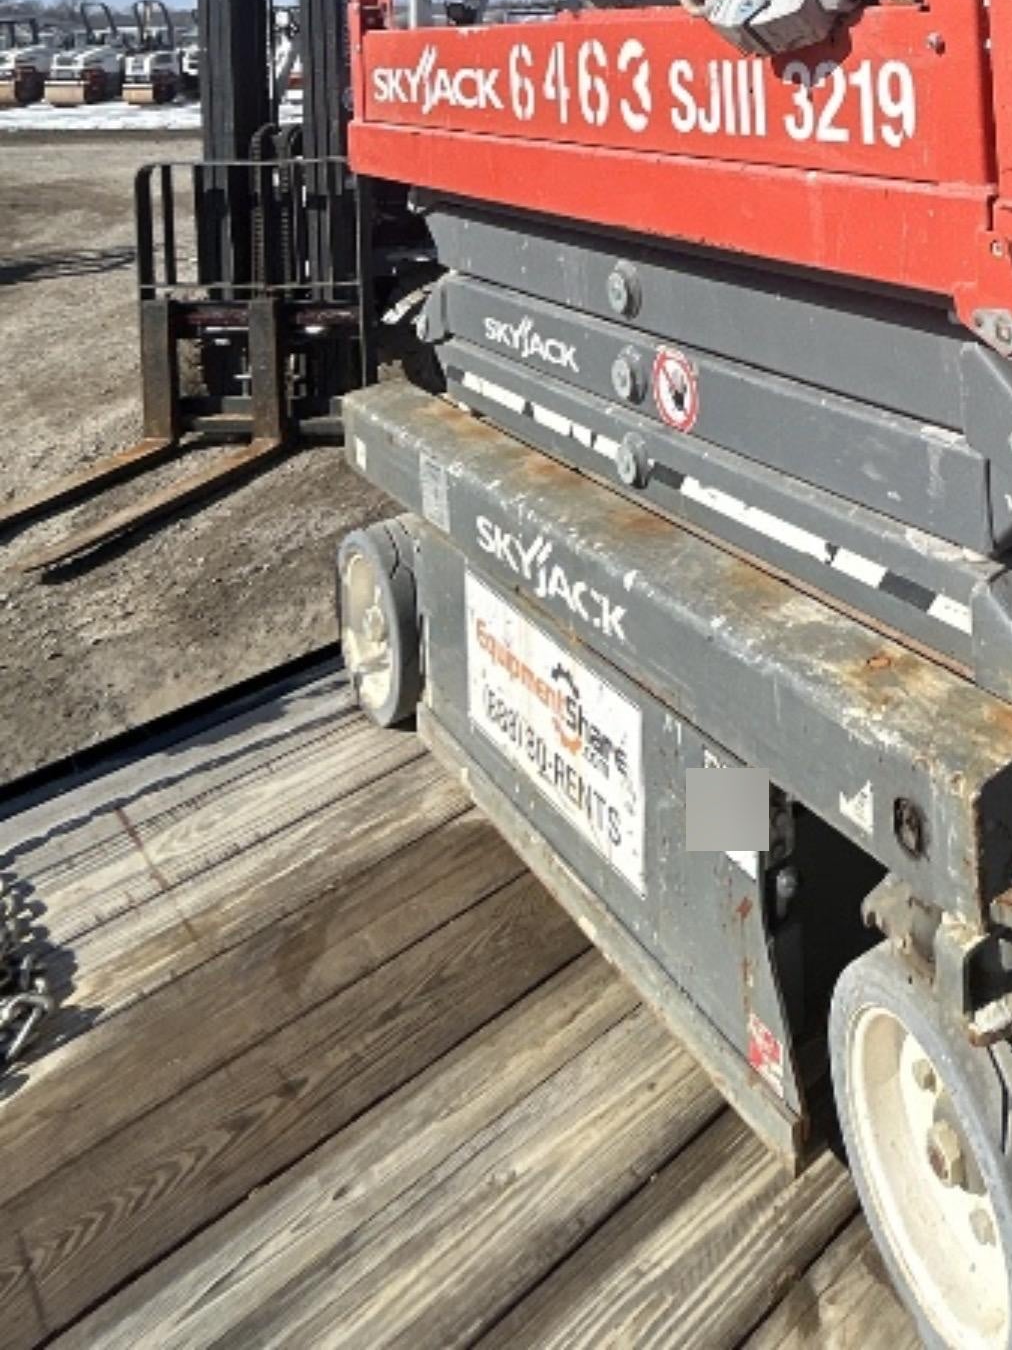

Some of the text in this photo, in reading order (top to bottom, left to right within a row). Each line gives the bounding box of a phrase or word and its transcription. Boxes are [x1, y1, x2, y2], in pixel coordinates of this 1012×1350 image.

[372, 44, 502, 115] SKYJACK
[508, 37, 652, 133] 6463
[783, 59, 916, 148] 3219
[483, 315, 580, 373] SKYJACK
[475, 514, 628, 643] SKYJACK
